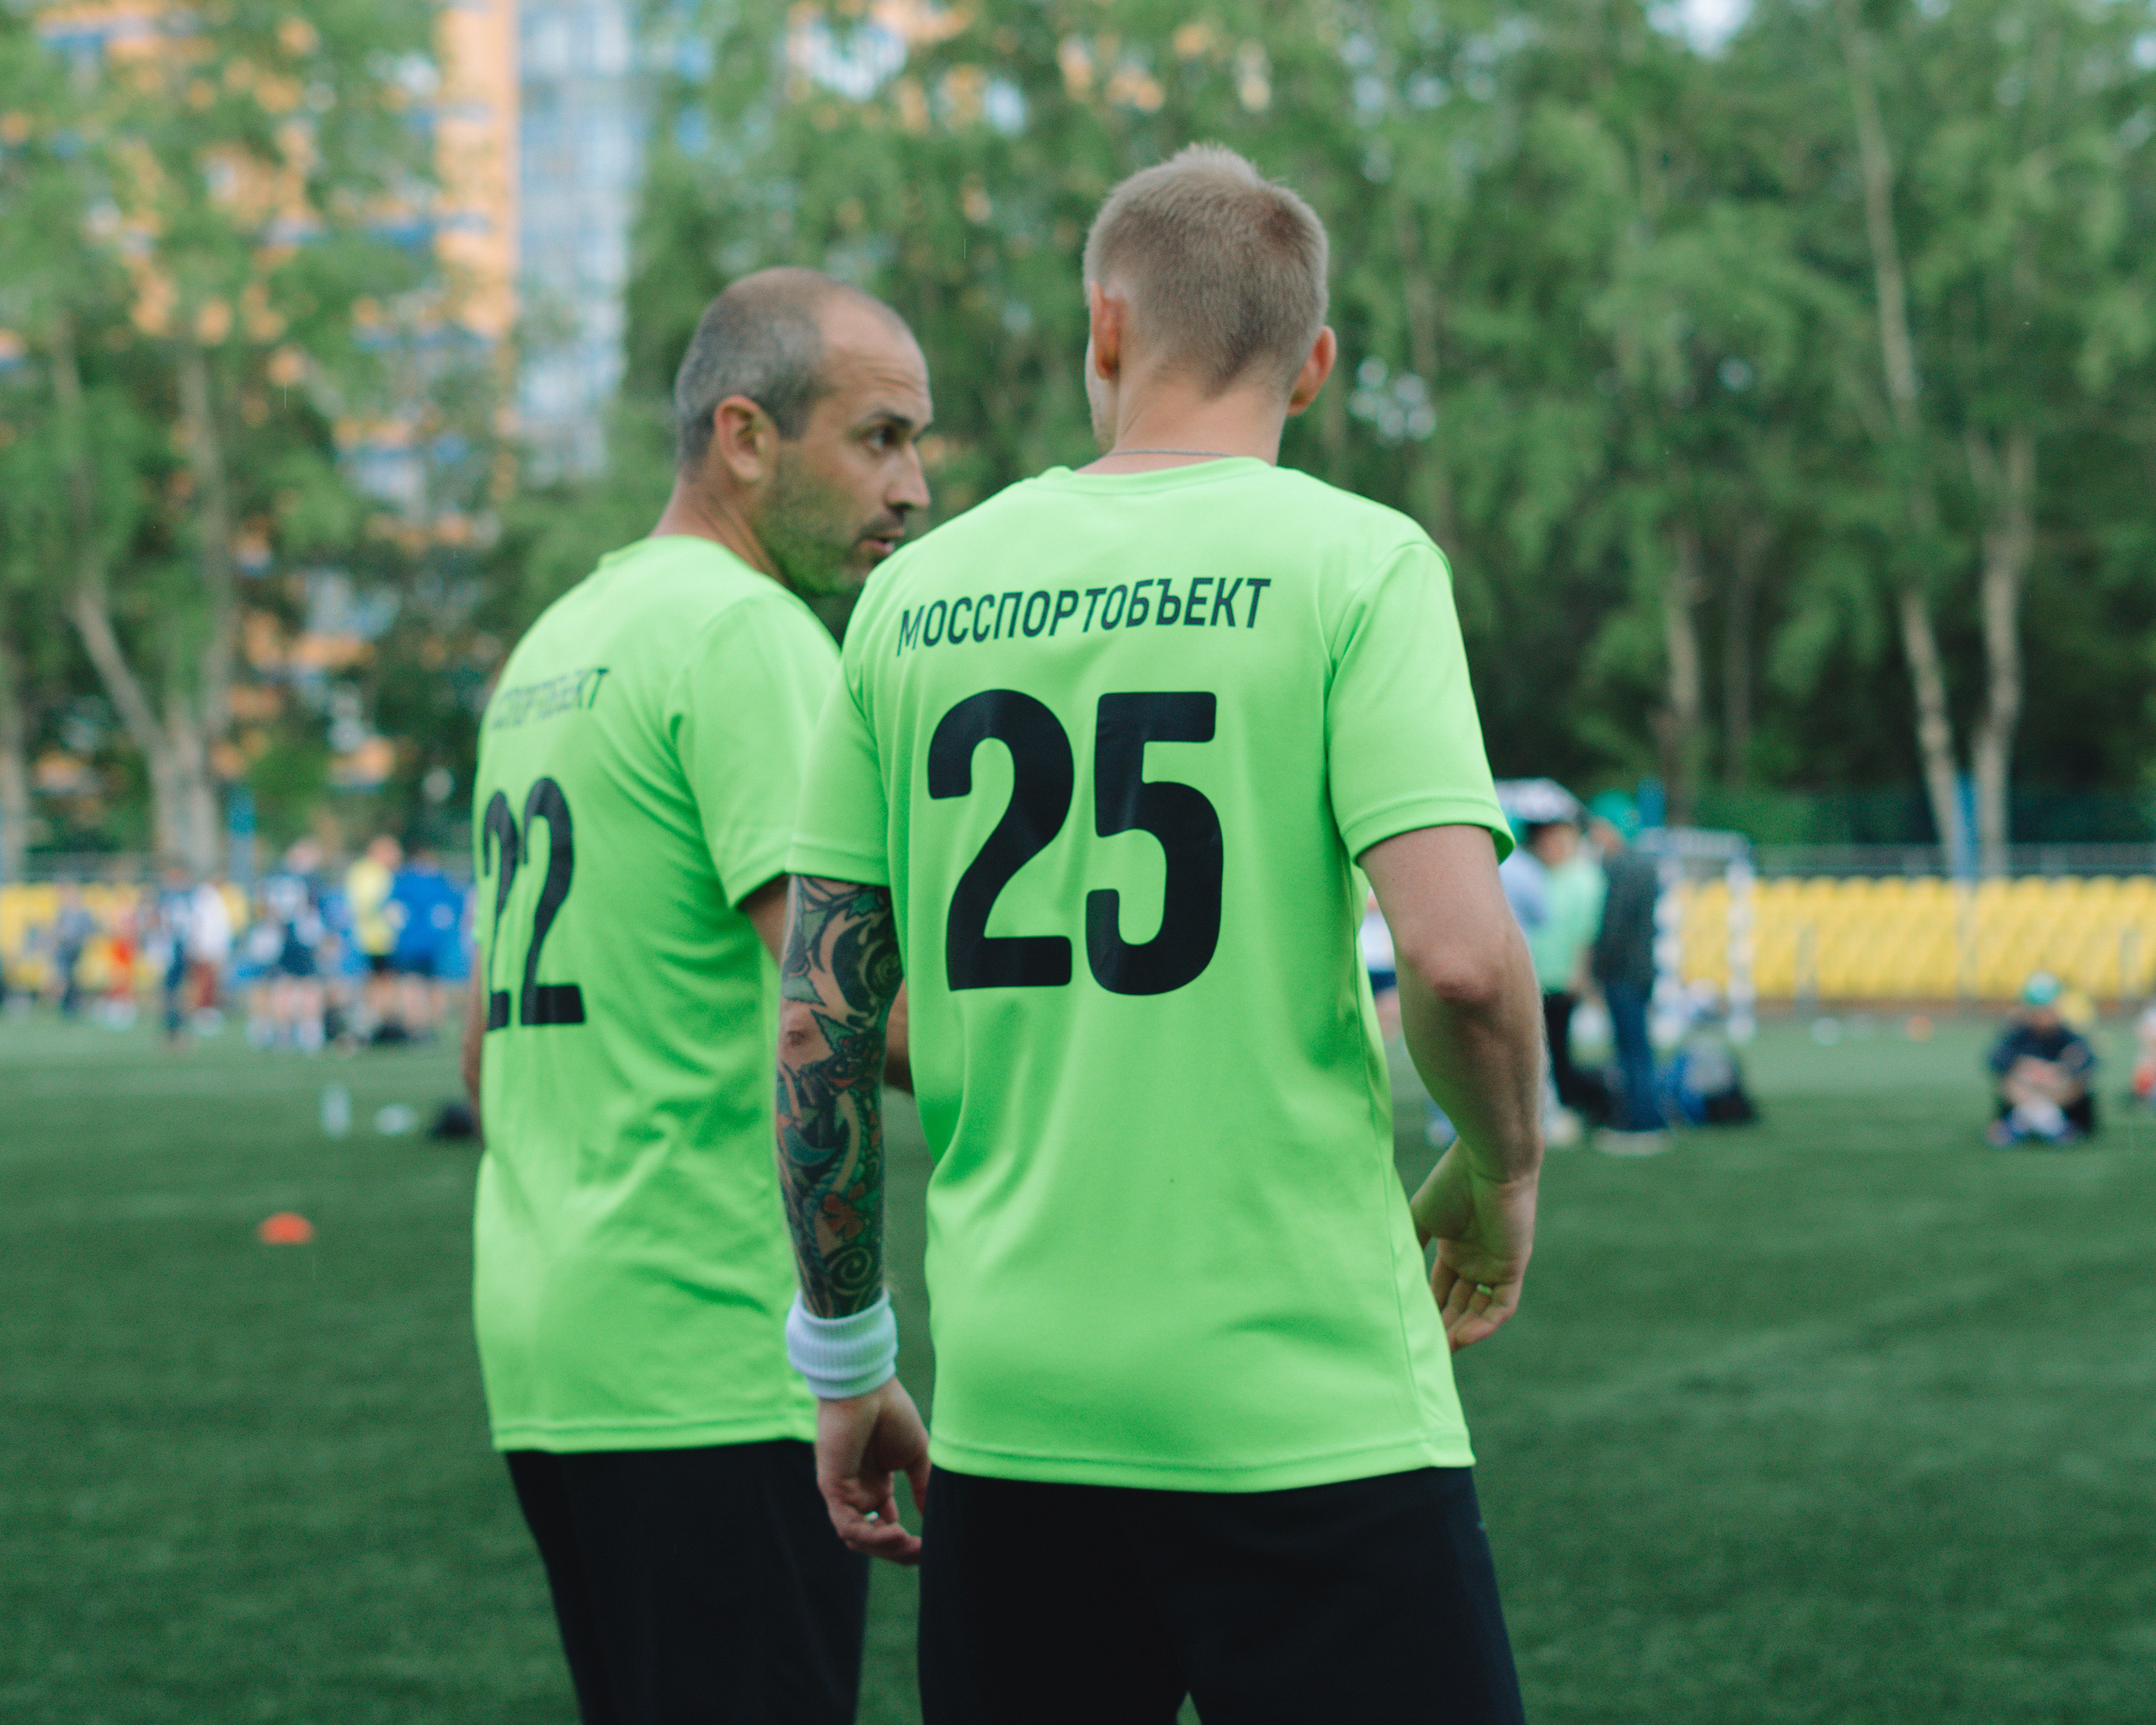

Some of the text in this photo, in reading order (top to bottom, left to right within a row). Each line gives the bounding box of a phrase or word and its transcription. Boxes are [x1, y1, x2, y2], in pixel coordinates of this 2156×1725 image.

[896, 577, 1272, 657] МОССПОРТОБЪЕКТ
[483, 776, 586, 1033] 22
[927, 688, 1224, 996] 25
